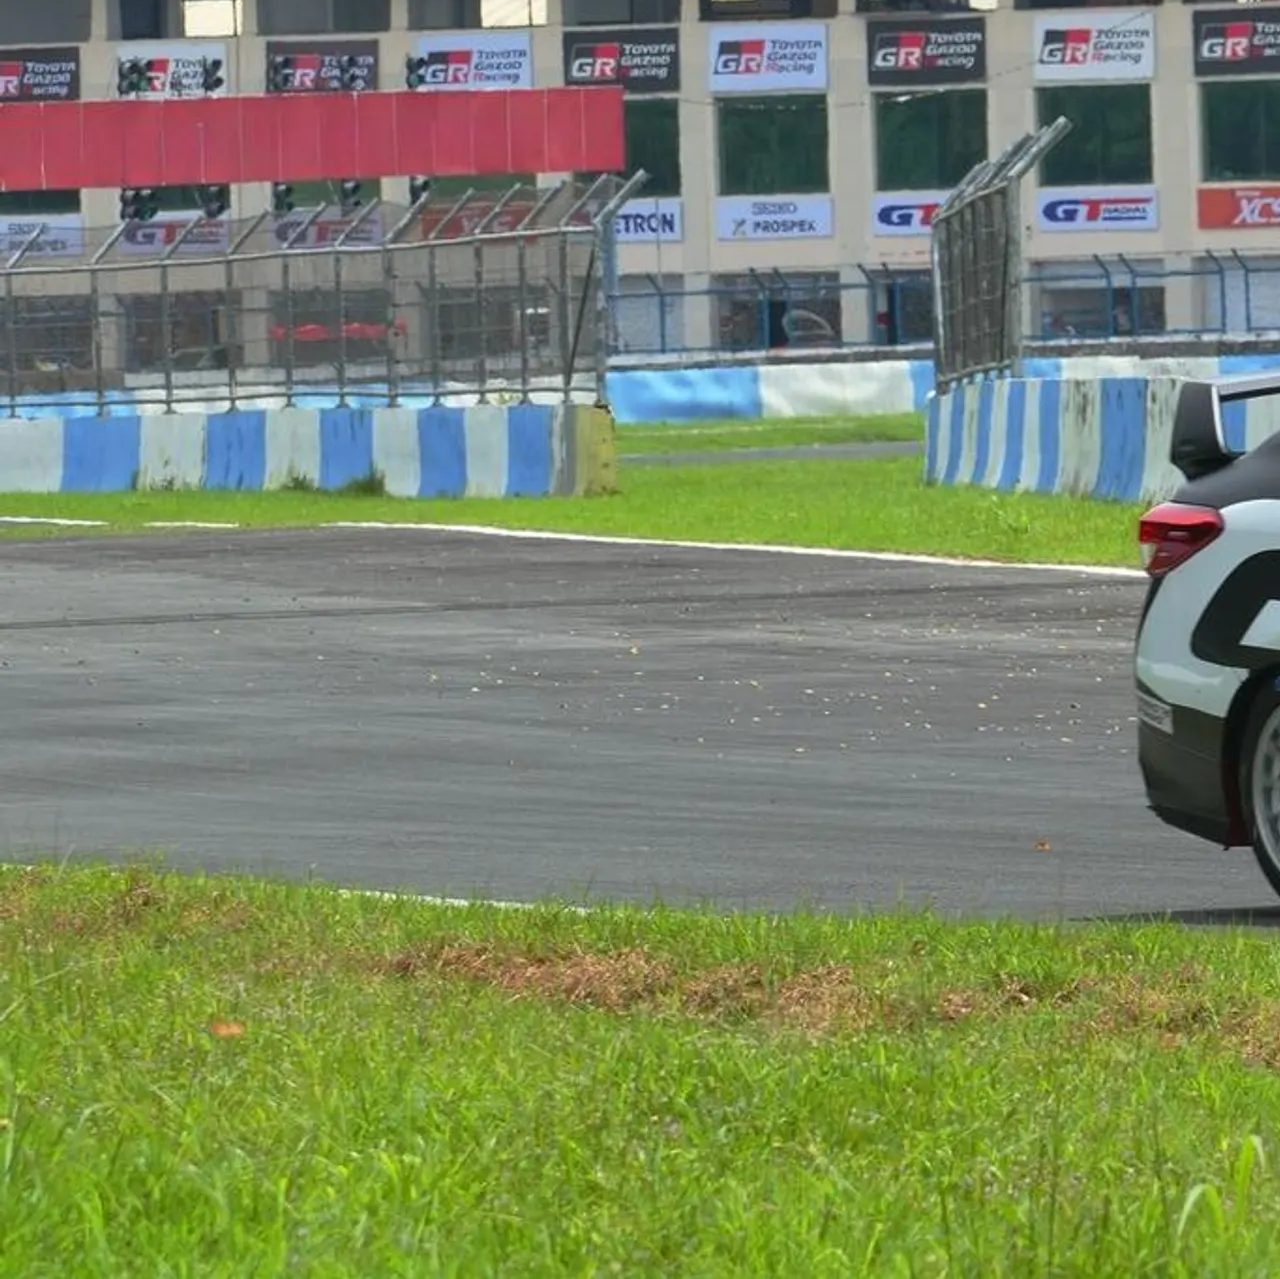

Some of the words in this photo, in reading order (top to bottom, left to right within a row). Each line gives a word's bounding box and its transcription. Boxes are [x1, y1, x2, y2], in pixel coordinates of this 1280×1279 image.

[928, 32, 982, 43] TOYOTA
[1096, 29, 1150, 39] TOYOTA
[623, 43, 676, 54] TOYOTA
[771, 40, 822, 50] TOYOTA
[926, 44, 976, 54] GAZOO
[1094, 41, 1144, 51] GAZOO
[1202, 39, 1249, 58] GR
[477, 49, 527, 60] TOYOTA
[768, 51, 816, 61] GAZOO
[1041, 43, 1088, 62] GR
[621, 54, 670, 65] GAZOO
[715, 54, 762, 72] GR
[875, 49, 922, 68] GR
[24, 61, 76, 73] TOYOTA
[475, 61, 522, 70] GAZOO
[571, 58, 616, 78] GR
[23, 73, 70, 83] GAZOO
[425, 63, 468, 83] GR
[752, 219, 817, 233] PROSPEX
